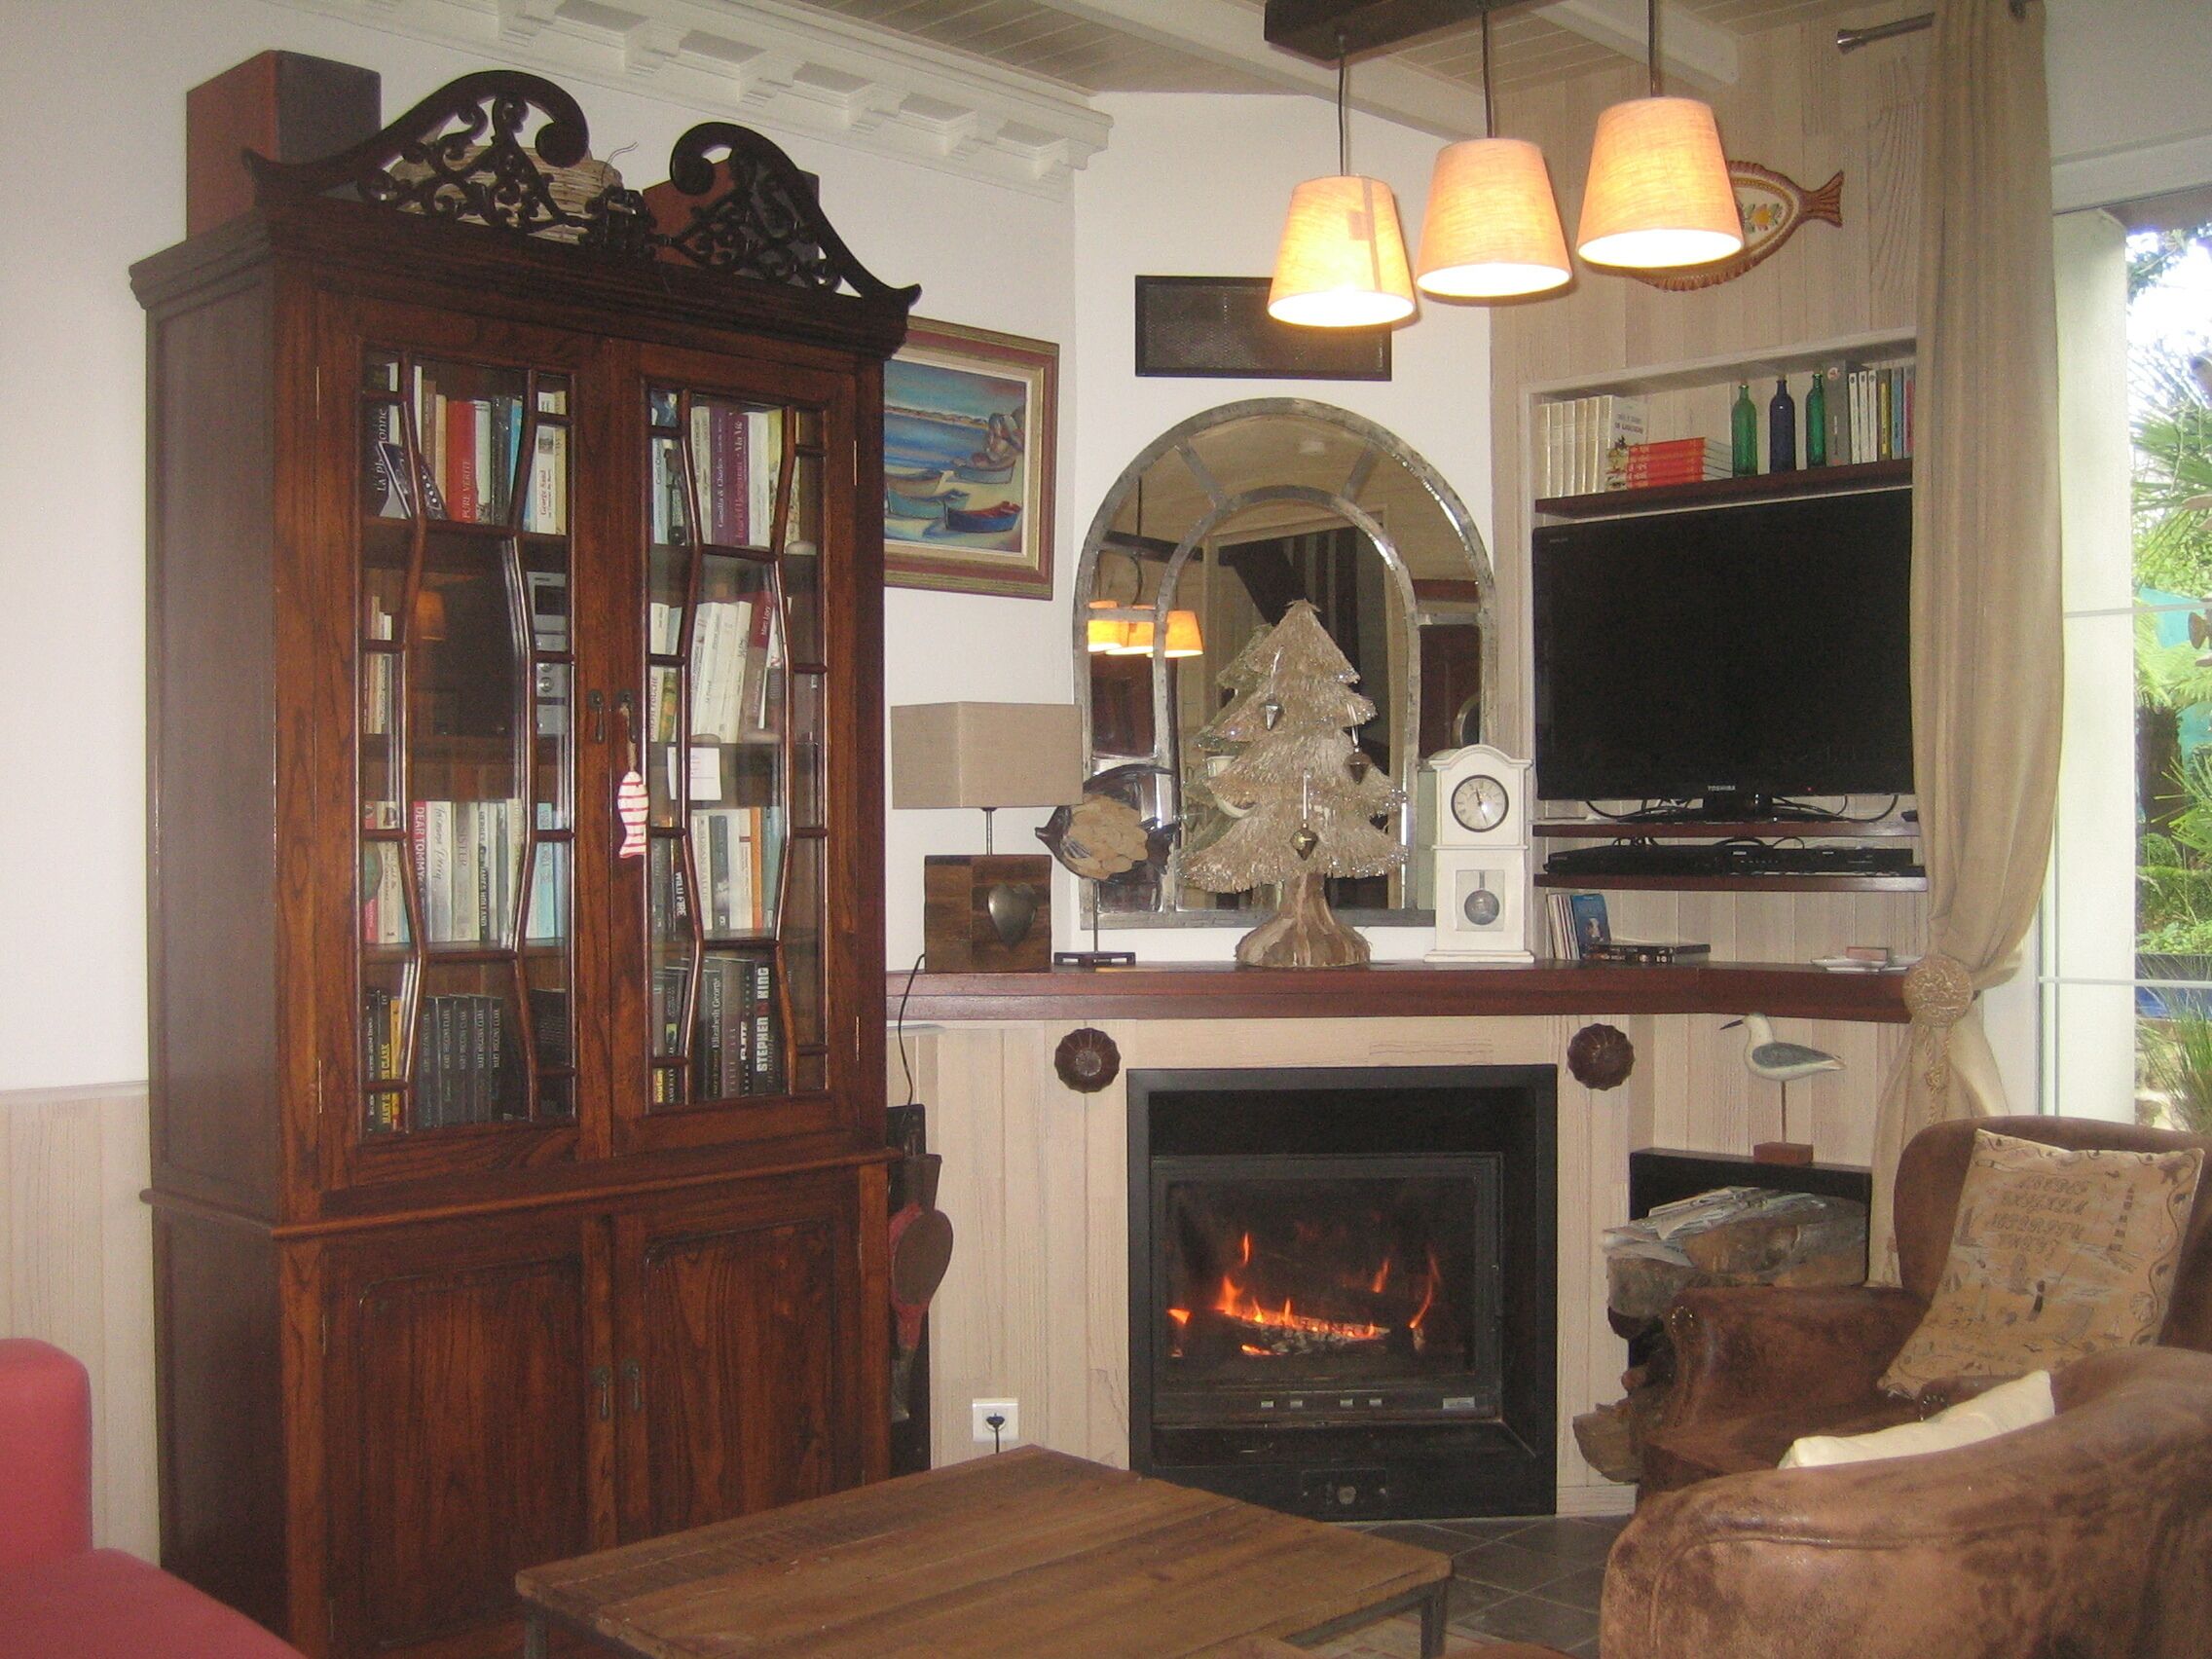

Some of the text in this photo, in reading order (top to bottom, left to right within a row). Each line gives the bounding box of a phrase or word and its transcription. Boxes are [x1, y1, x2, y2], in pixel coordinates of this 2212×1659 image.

[415, 806, 425, 877] DEAR TOMMY
[756, 967, 769, 1073] STEPHEN KING
